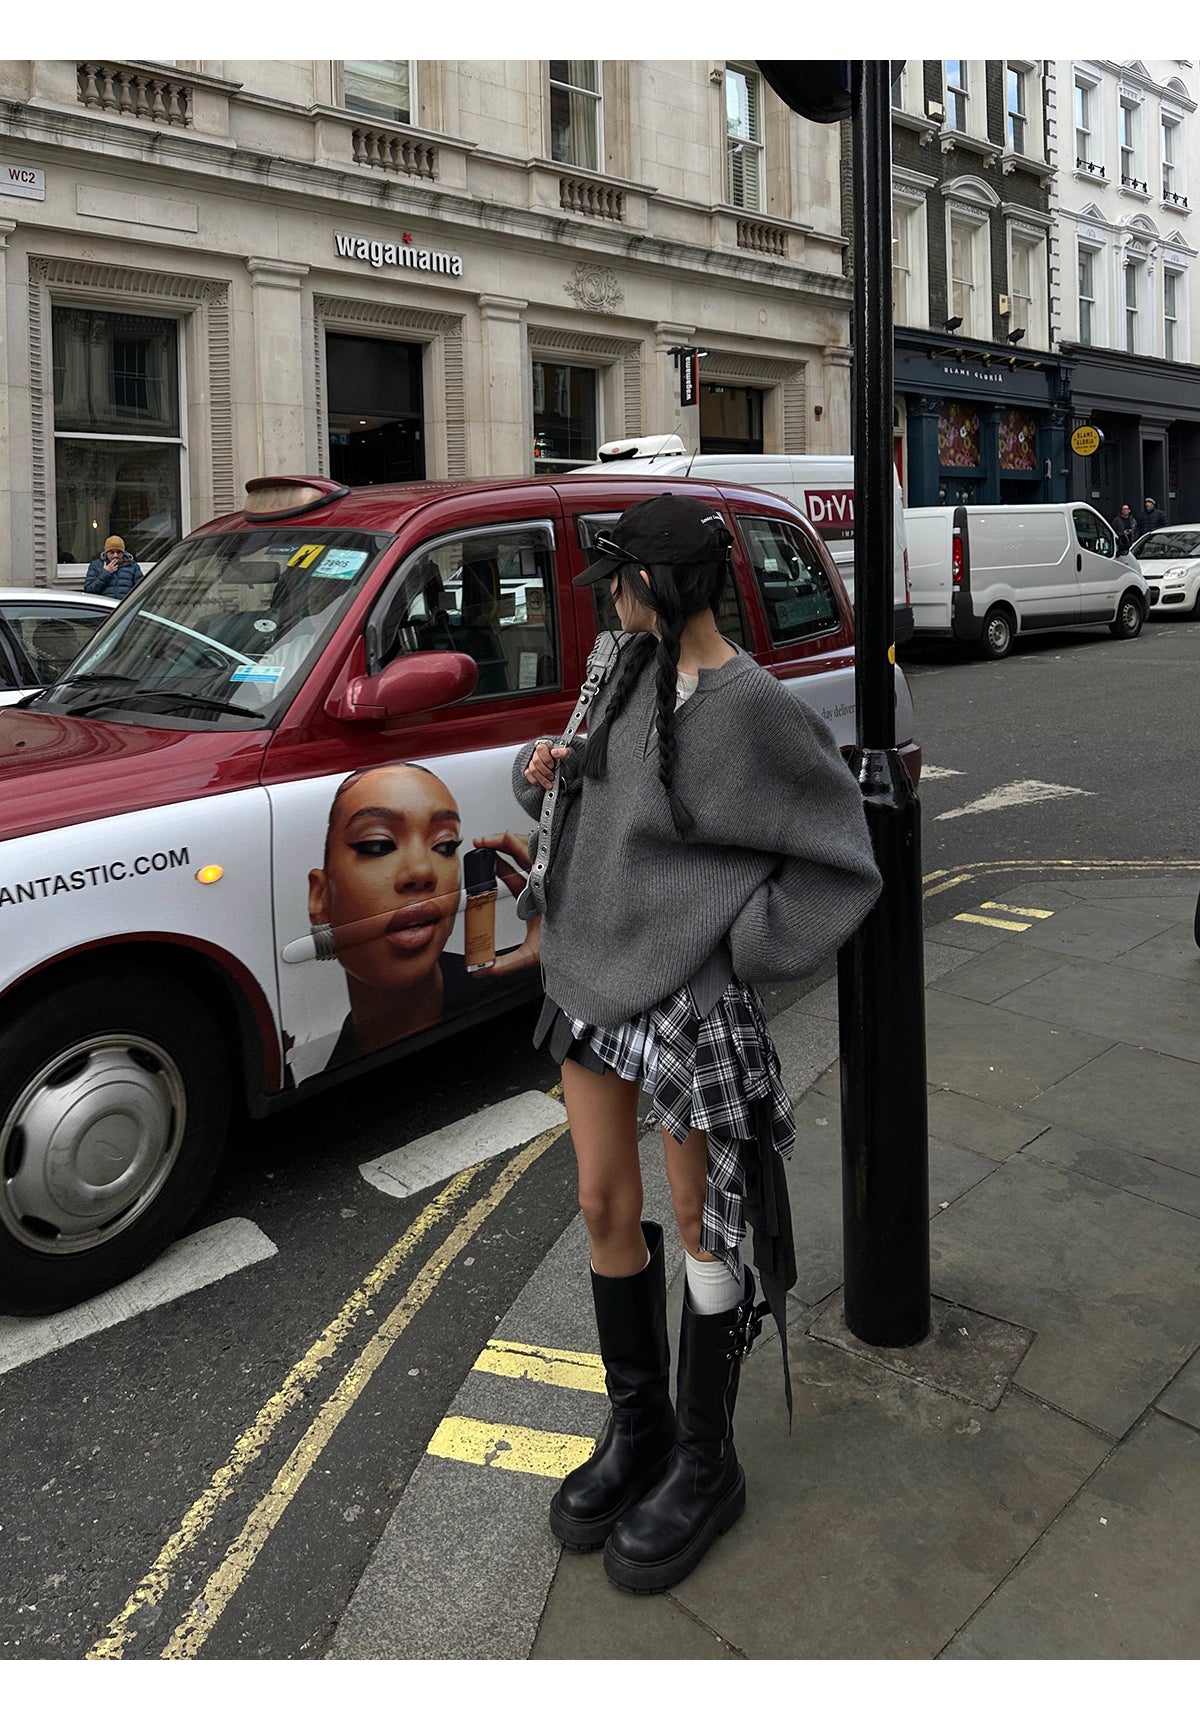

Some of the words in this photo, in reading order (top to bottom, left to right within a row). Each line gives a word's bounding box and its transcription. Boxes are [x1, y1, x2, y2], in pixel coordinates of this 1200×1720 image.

[8, 168, 36, 184] WC2
[334, 234, 463, 276] wagamama
[944, 367, 970, 376] BLAME
[974, 372, 1003, 382] GLORIA
